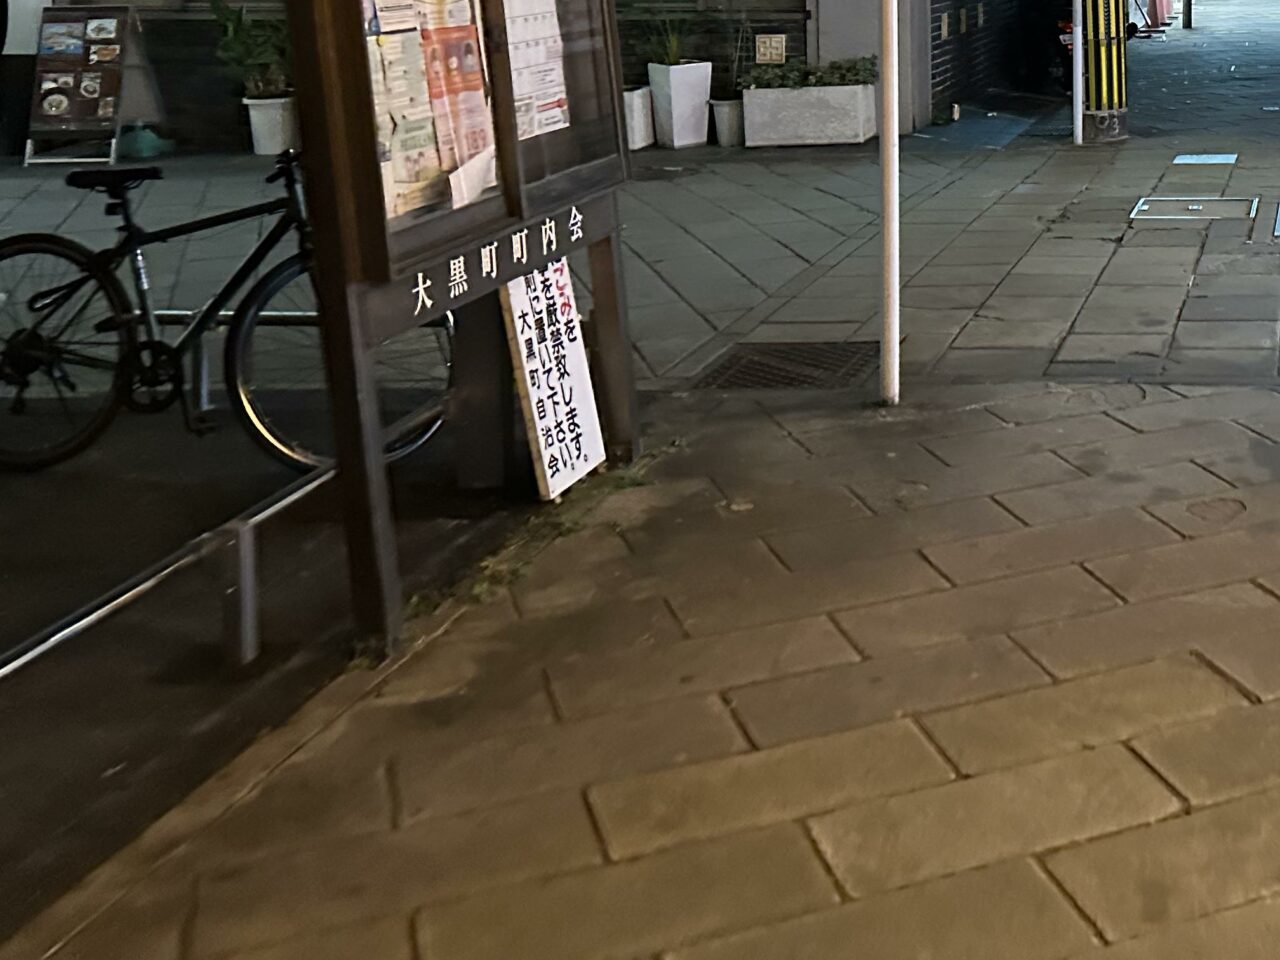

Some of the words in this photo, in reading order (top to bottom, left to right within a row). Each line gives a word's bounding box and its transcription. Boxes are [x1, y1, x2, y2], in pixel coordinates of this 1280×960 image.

[411, 206, 583, 316] 大黒町町内会
